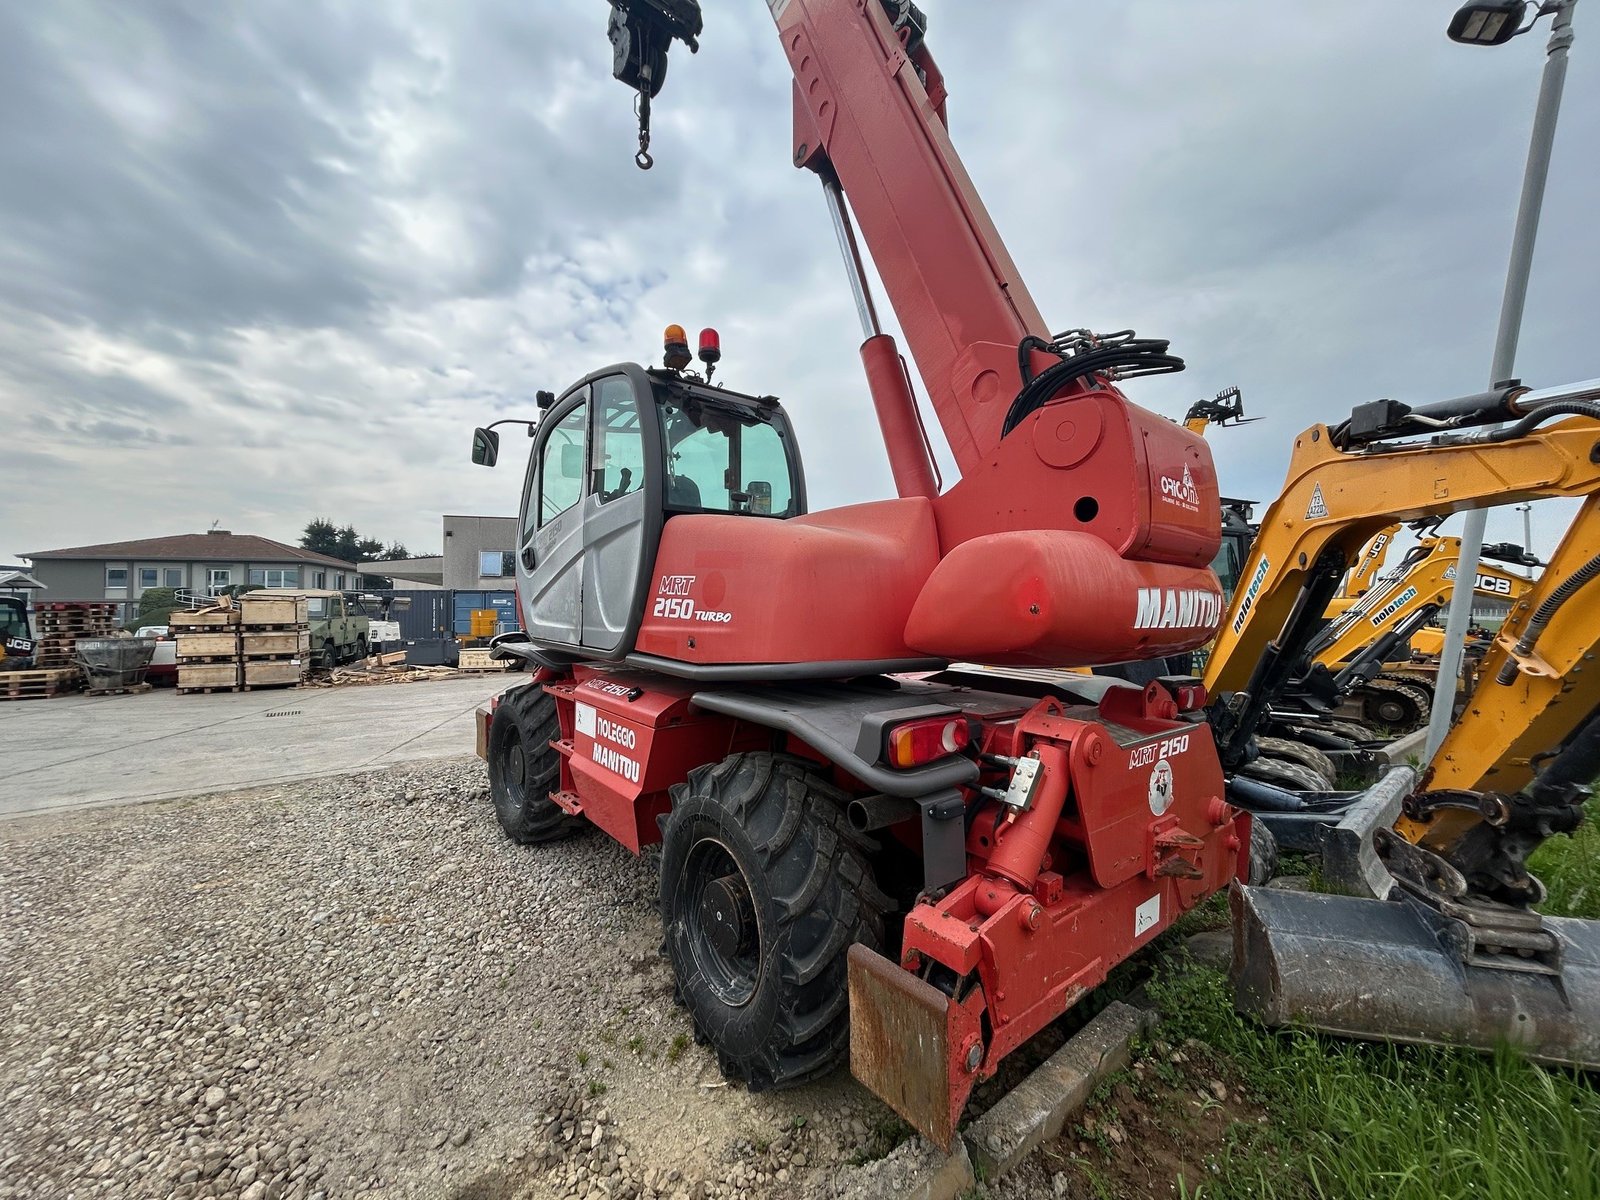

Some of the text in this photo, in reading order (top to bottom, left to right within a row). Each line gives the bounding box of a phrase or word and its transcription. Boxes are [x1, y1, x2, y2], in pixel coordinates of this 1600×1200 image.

[1370, 534, 1388, 558] JCB
[658, 575, 696, 595] MRT
[1234, 558, 1270, 635] nolotech
[1474, 574, 1511, 594] JCB
[653, 597, 732, 622] 2150 TURBO
[1134, 587, 1222, 629] MANITOU
[1372, 587, 1417, 626] nolotech
[6, 638, 32, 651] JCB
[602, 683, 631, 697] 2150
[592, 742, 641, 783] MANITOU
[1129, 734, 1190, 770] MRT 2150
